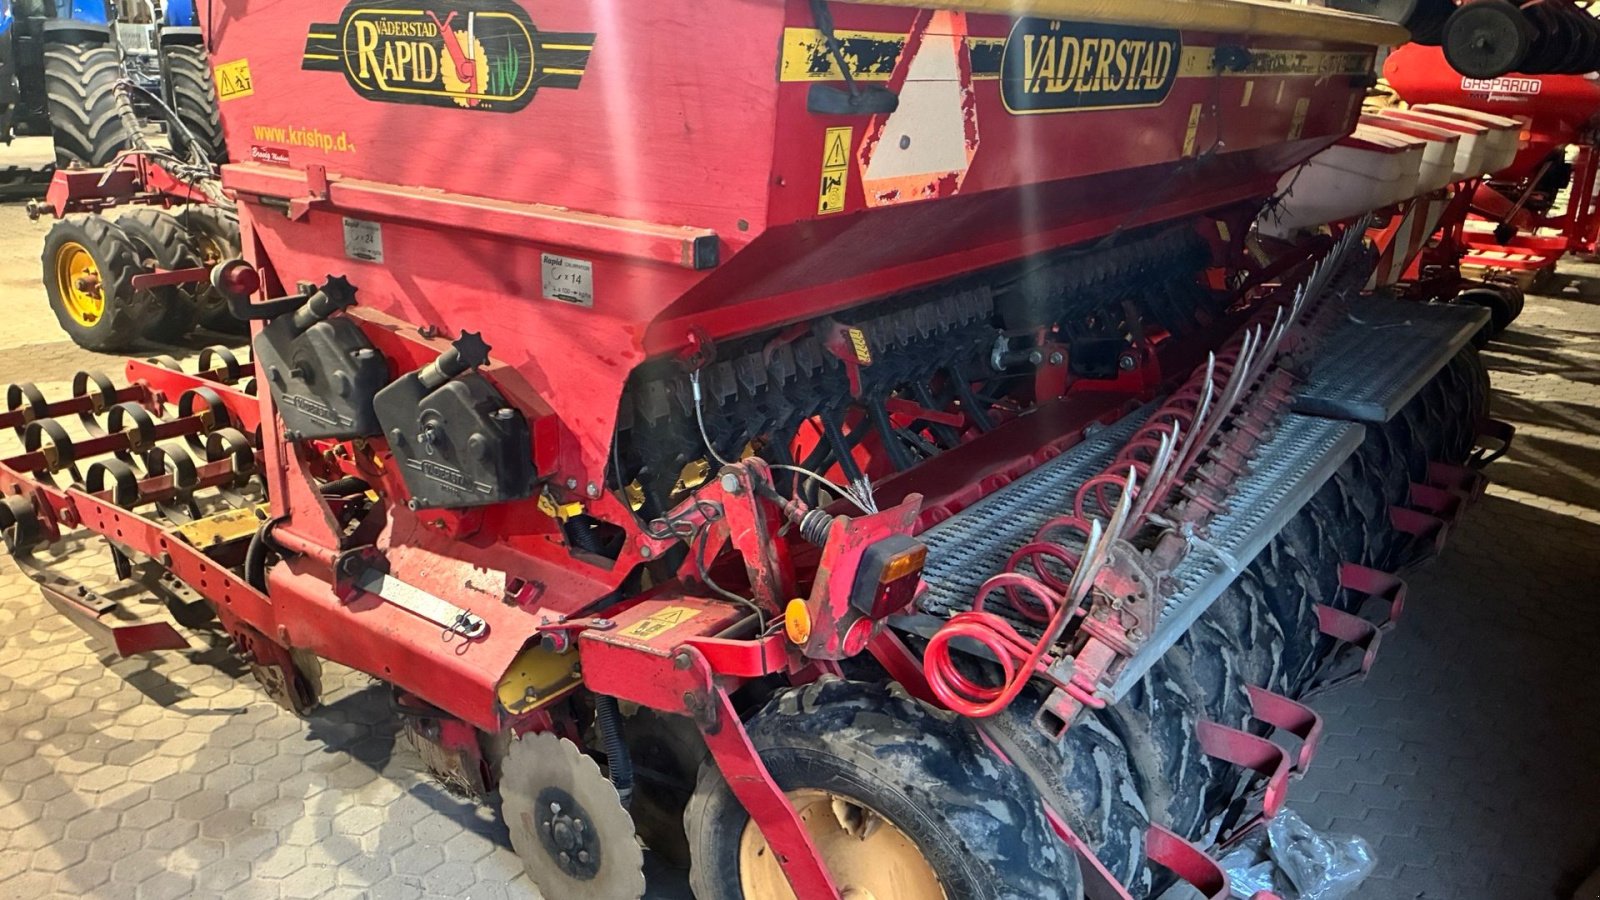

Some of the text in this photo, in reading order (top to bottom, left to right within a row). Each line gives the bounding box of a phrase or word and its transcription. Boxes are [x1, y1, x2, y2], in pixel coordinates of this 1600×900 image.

[375, 17, 437, 37] VÄDERSTAD
[354, 21, 437, 84] RAPID
[1023, 21, 1172, 93] VÄDERSTAD
[1463, 78, 1540, 93] GASPARDO
[253, 125, 356, 154] www.krishp.d
[543, 255, 562, 266] Rapid
[571, 273, 581, 284] 14
